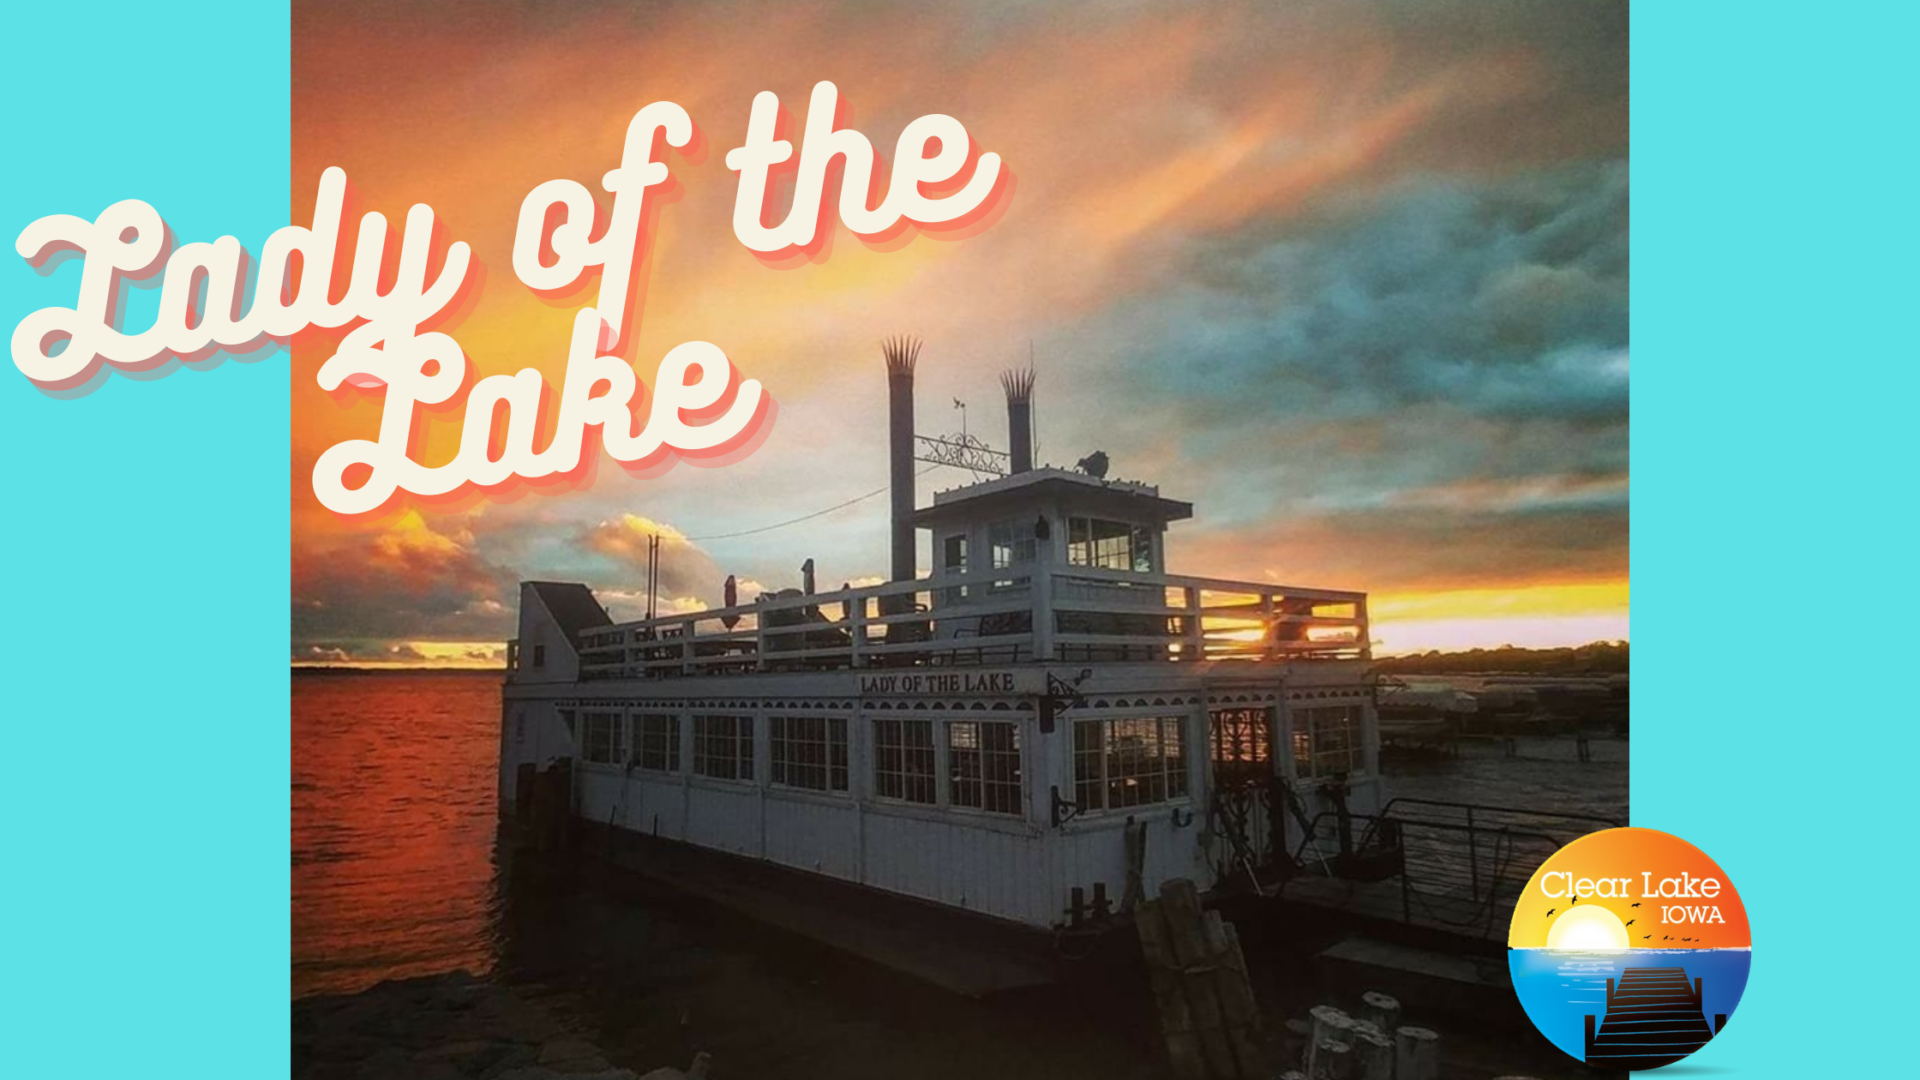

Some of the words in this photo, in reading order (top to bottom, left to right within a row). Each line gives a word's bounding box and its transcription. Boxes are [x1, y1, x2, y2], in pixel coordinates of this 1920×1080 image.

[861, 676, 897, 692] LADY
[902, 676, 922, 692] OF
[925, 674, 960, 692] THE
[965, 673, 1014, 691] LAKE
